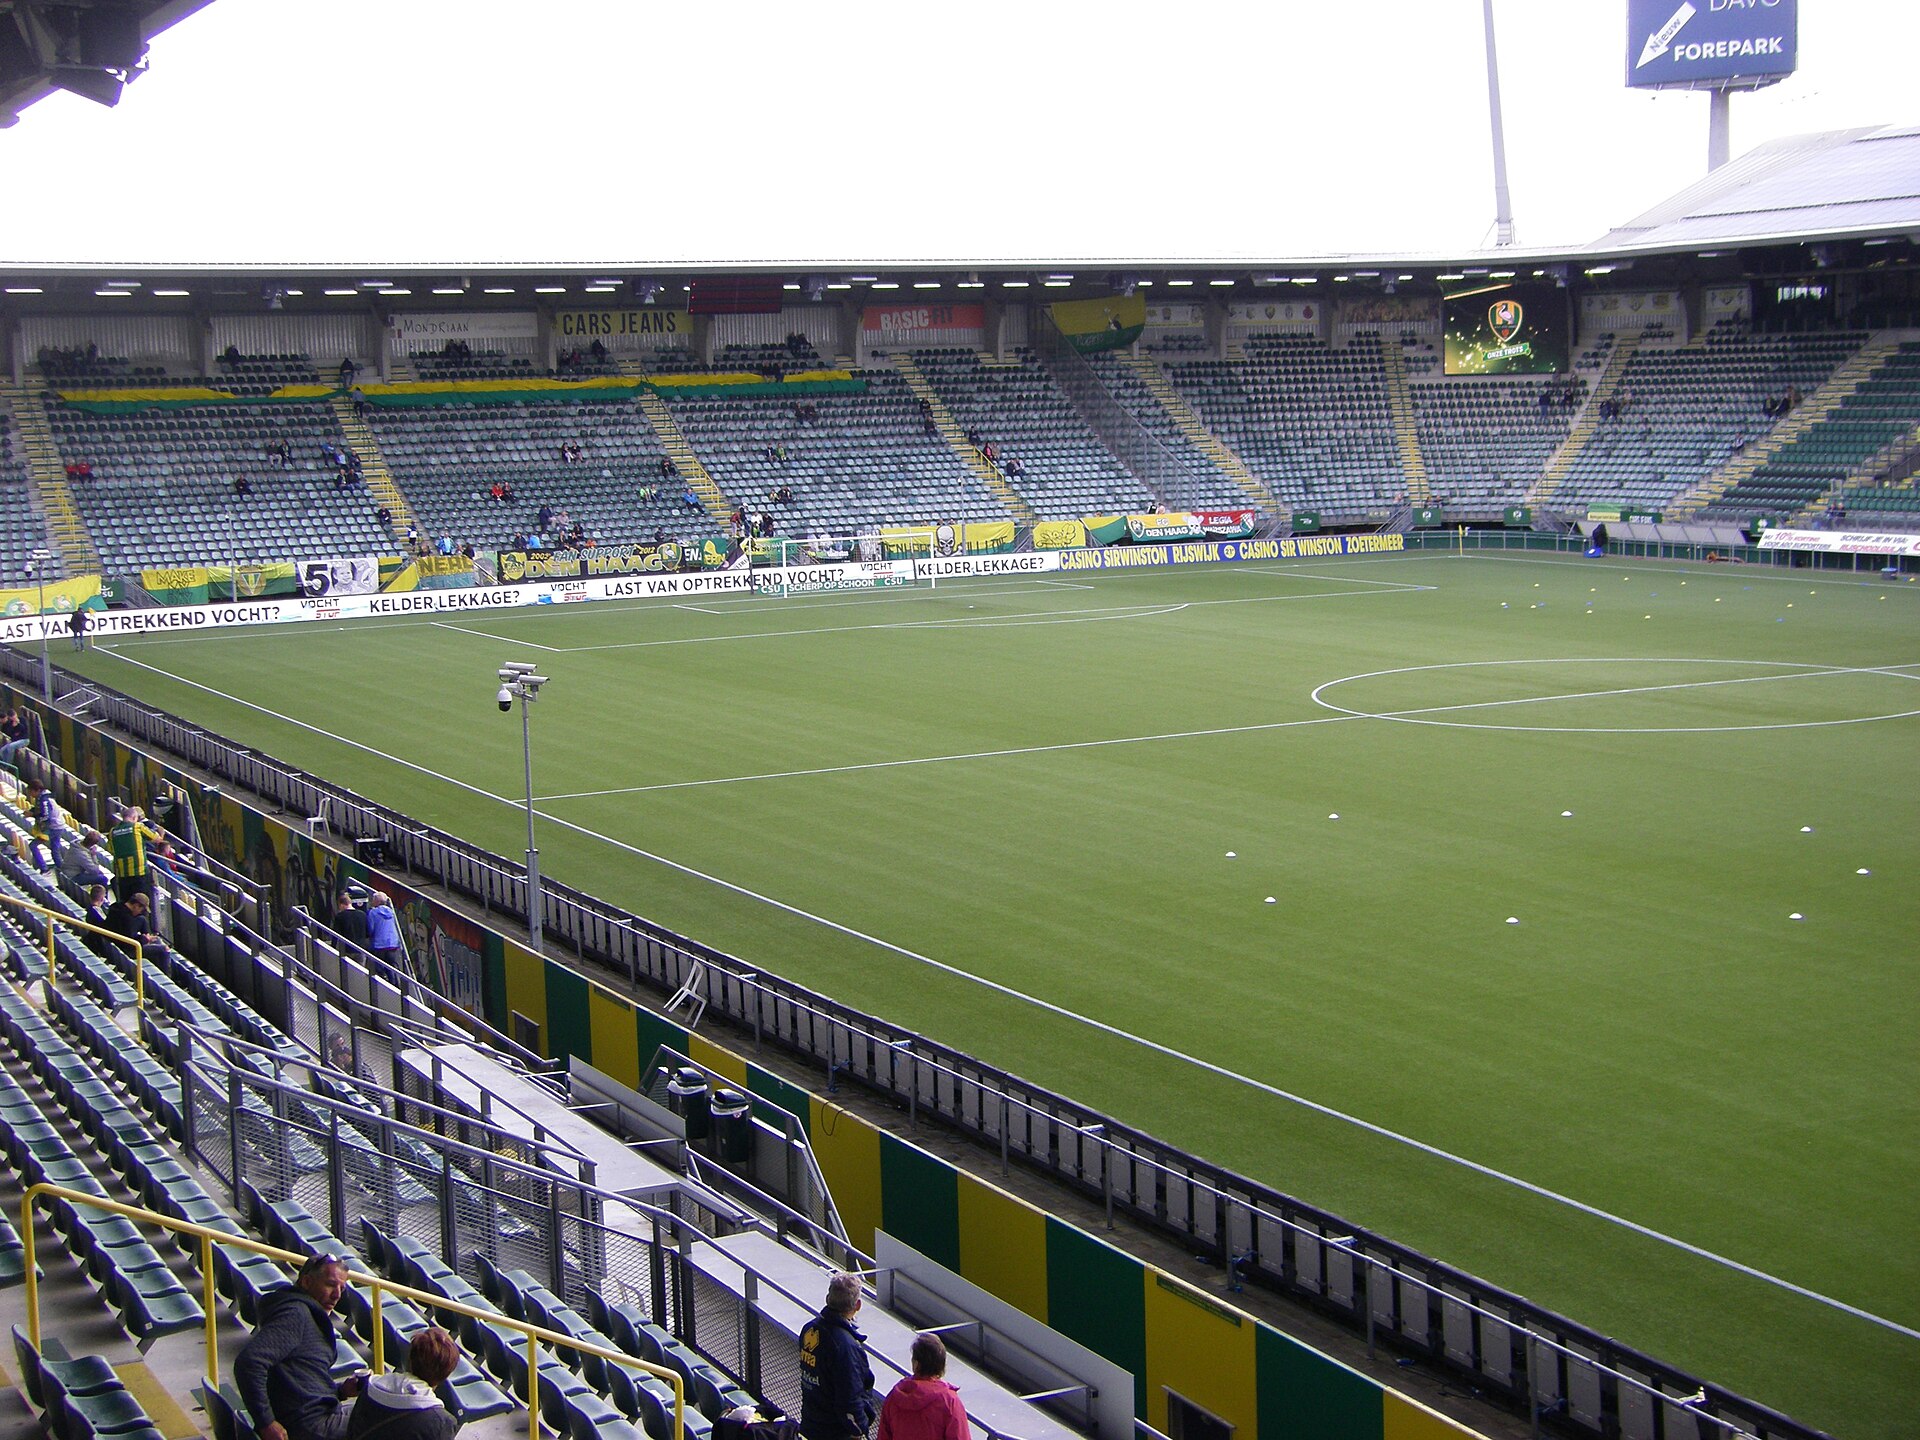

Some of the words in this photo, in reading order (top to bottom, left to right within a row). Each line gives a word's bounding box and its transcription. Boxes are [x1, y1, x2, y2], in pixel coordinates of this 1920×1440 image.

[1649, 18, 1681, 53] Nieuw
[1674, 36, 1783, 62] FOREPARK
[402, 317, 470, 335] MONDRIAAN
[562, 313, 612, 335] CARS
[620, 311, 676, 334] JEANS
[880, 309, 929, 331] BASIC
[1208, 516, 1233, 525] LEGIA
[1145, 528, 1163, 537] DEN
[1164, 526, 1189, 536] HAAG
[1774, 532, 1794, 541] 10%
[552, 549, 578, 562] FAN
[580, 545, 637, 561] SUPPORT
[639, 546, 656, 555] 2012
[1239, 540, 1279, 560] CASINO
[1279, 539, 1297, 558] SIR
[1297, 536, 1343, 557] WINSTON
[1346, 533, 1405, 553] ZOETERMEER
[1060, 550, 1102, 570] CASINO
[1173, 543, 1221, 563] RIJSWIJK
[525, 558, 581, 578] DEN
[587, 553, 663, 575] HAAG
[860, 562, 893, 572] VOCHT
[917, 561, 972, 576] KELDER
[975, 557, 1044, 573] LEKKAGE?
[156, 569, 196, 585] MAKE
[604, 581, 643, 597] LAST
[647, 579, 679, 594] VAN
[682, 572, 783, 591] OPTREKKEND
[787, 569, 845, 585] VOCHT?
[884, 577, 904, 586] CSU
[550, 581, 587, 592] VOCHT
[760, 585, 781, 594] CSU
[788, 583, 823, 593] SCHERP
[823, 581, 837, 590] OP
[300, 598, 340, 609] VOCHT
[369, 596, 434, 613] KELDER
[438, 590, 521, 608] LEKKAGE?
[0, 623, 34, 639] AST
[85, 611, 206, 632] OPTREKKEND
[211, 606, 280, 624] VOCHT?
